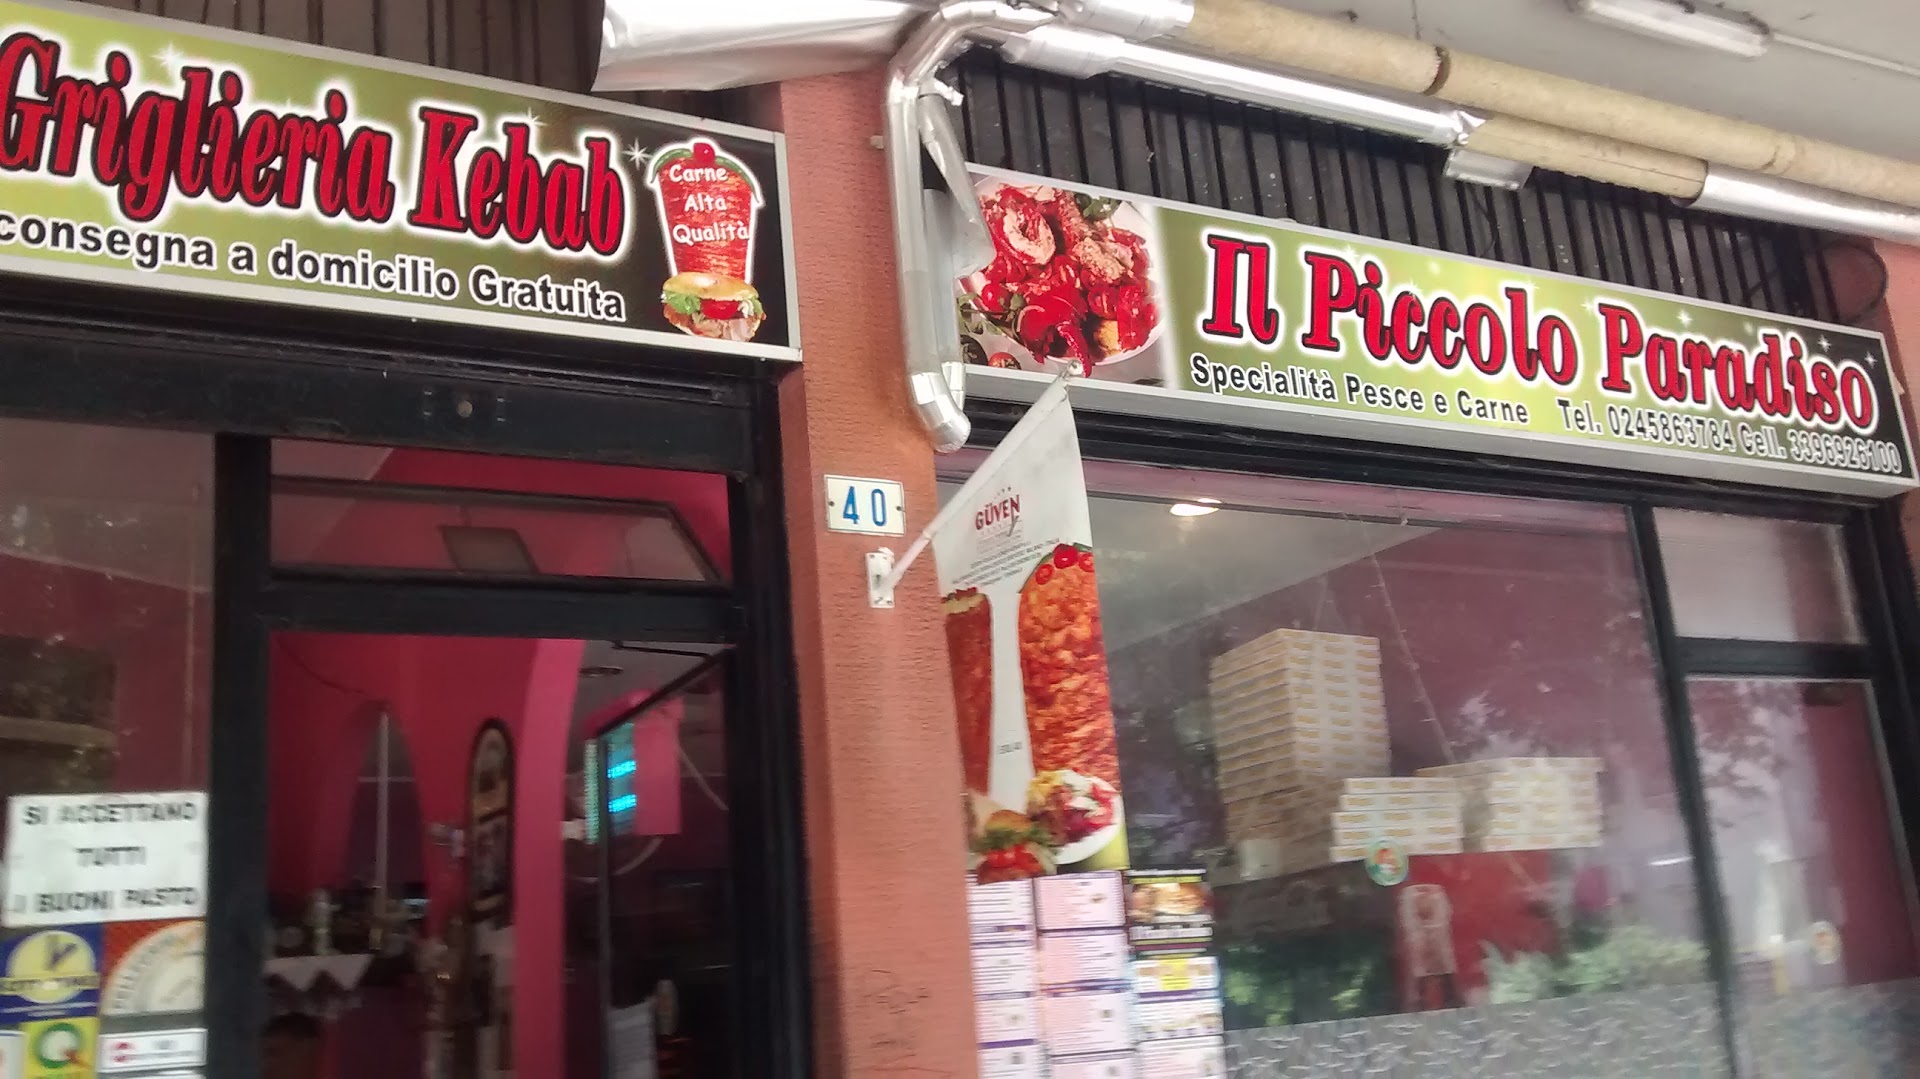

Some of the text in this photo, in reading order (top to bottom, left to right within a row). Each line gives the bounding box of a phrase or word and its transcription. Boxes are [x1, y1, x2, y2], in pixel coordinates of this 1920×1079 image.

[0, 32, 626, 256] Griglieria Kebab
[669, 164, 728, 183] Carne
[684, 193, 727, 212] Alta
[672, 221, 750, 246] Qualità
[0, 213, 624, 320] consegna a domicilio Gratuita
[1202, 234, 1873, 428] Il Piccolo Paradiso
[1193, 354, 1336, 401] Specialità
[1348, 375, 1424, 411] Pesce
[1436, 394, 1448, 413] e
[1458, 390, 1528, 424] Carne
[1558, 399, 1601, 433] Tel.
[1607, 405, 1735, 452] 0245863784
[1740, 423, 1787, 458] Cell.
[842, 485, 888, 527] 40
[975, 494, 1020, 533] GÜVEN
